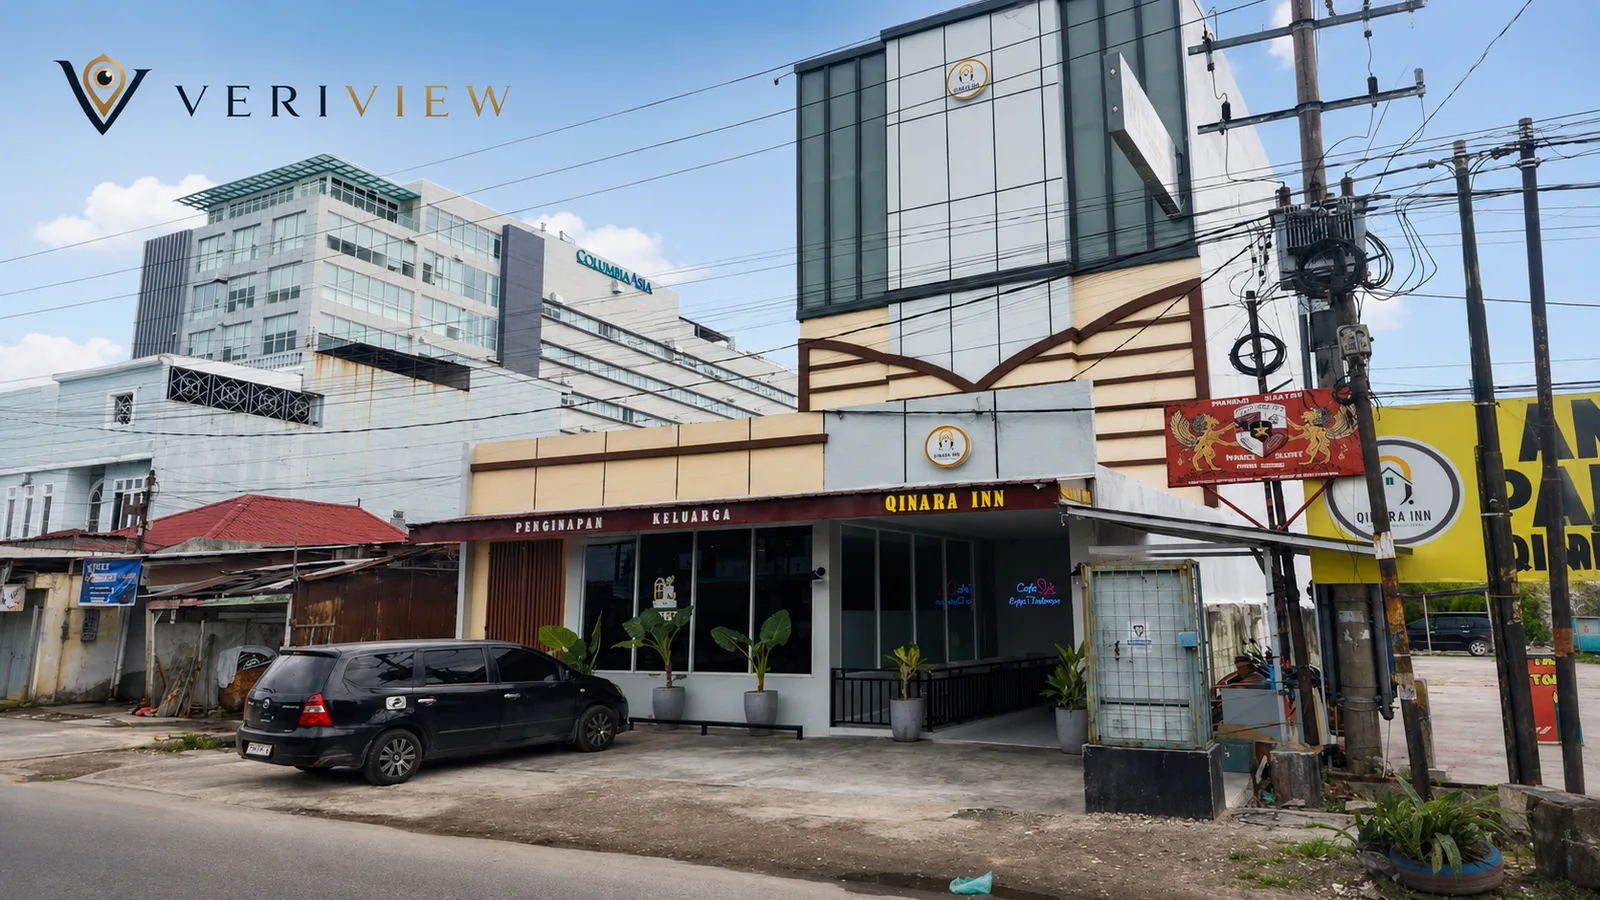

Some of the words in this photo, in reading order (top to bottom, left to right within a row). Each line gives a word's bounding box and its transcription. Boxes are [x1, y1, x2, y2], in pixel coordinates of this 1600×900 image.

[576, 249, 631, 286] COLUMBIA
[631, 273, 653, 295] ASIA
[885, 492, 958, 512] QINARA
[972, 490, 1004, 508] INN
[516, 517, 602, 533] PENGINAPAN
[653, 508, 730, 525] KELUARGA
[1357, 511, 1405, 524] QIRA
[1410, 510, 1431, 521] INN
